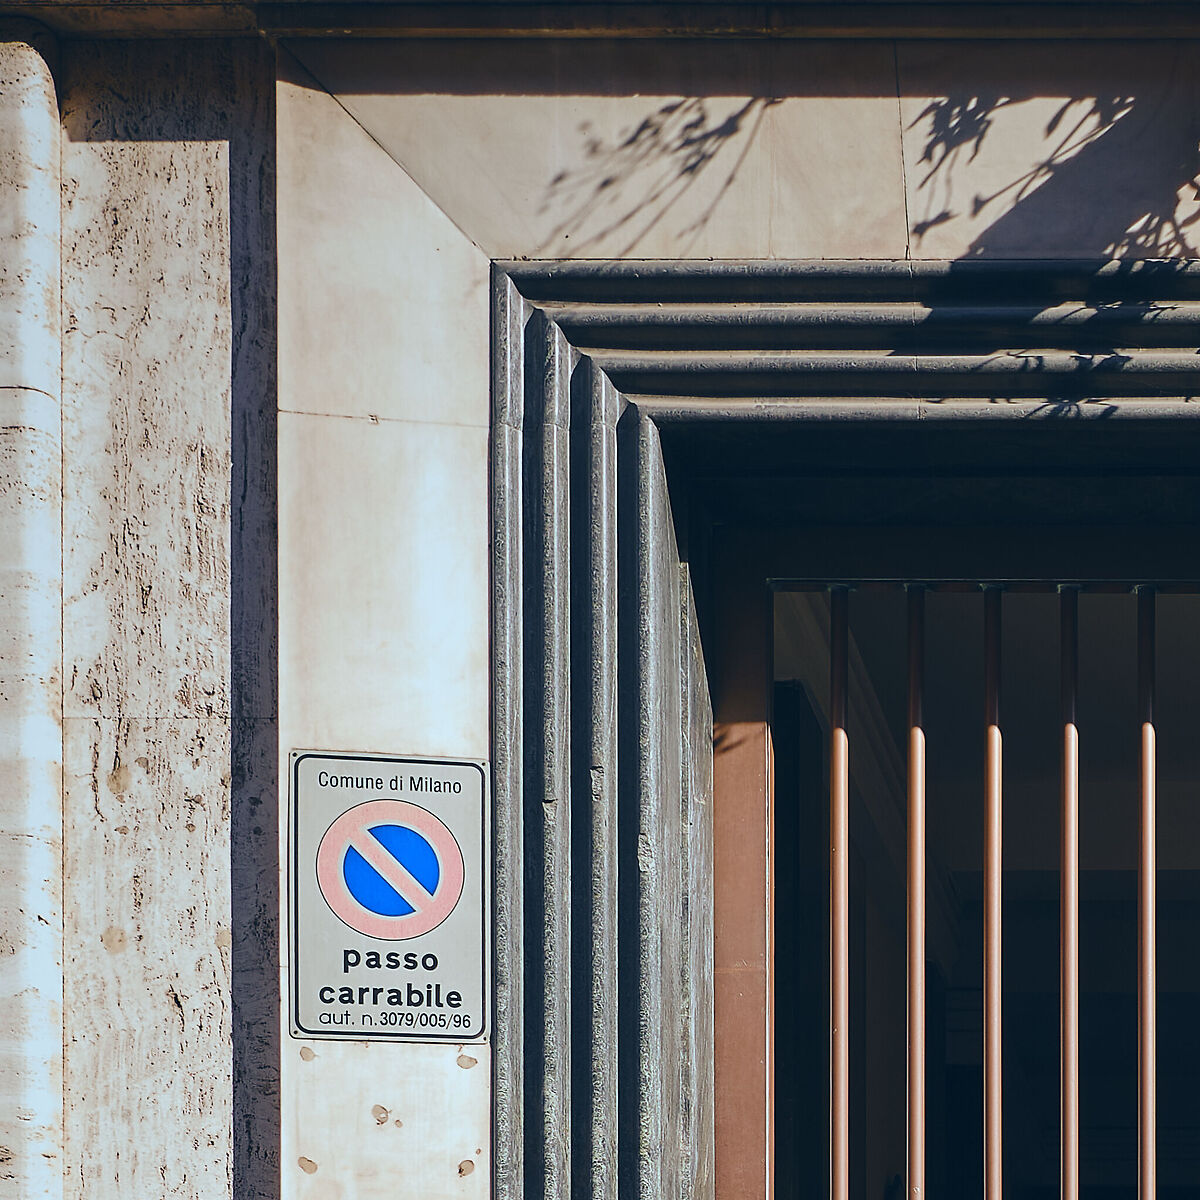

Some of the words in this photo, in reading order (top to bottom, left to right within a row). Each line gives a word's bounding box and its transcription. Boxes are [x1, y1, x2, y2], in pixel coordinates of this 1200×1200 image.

[317, 771, 384, 790] Comune
[389, 774, 404, 791] di
[409, 775, 462, 794] Milano
[343, 948, 439, 973] passo
[318, 983, 463, 1008] carrabile
[318, 1010, 355, 1026] aut.
[379, 1012, 471, 1029] 3079/005/96
